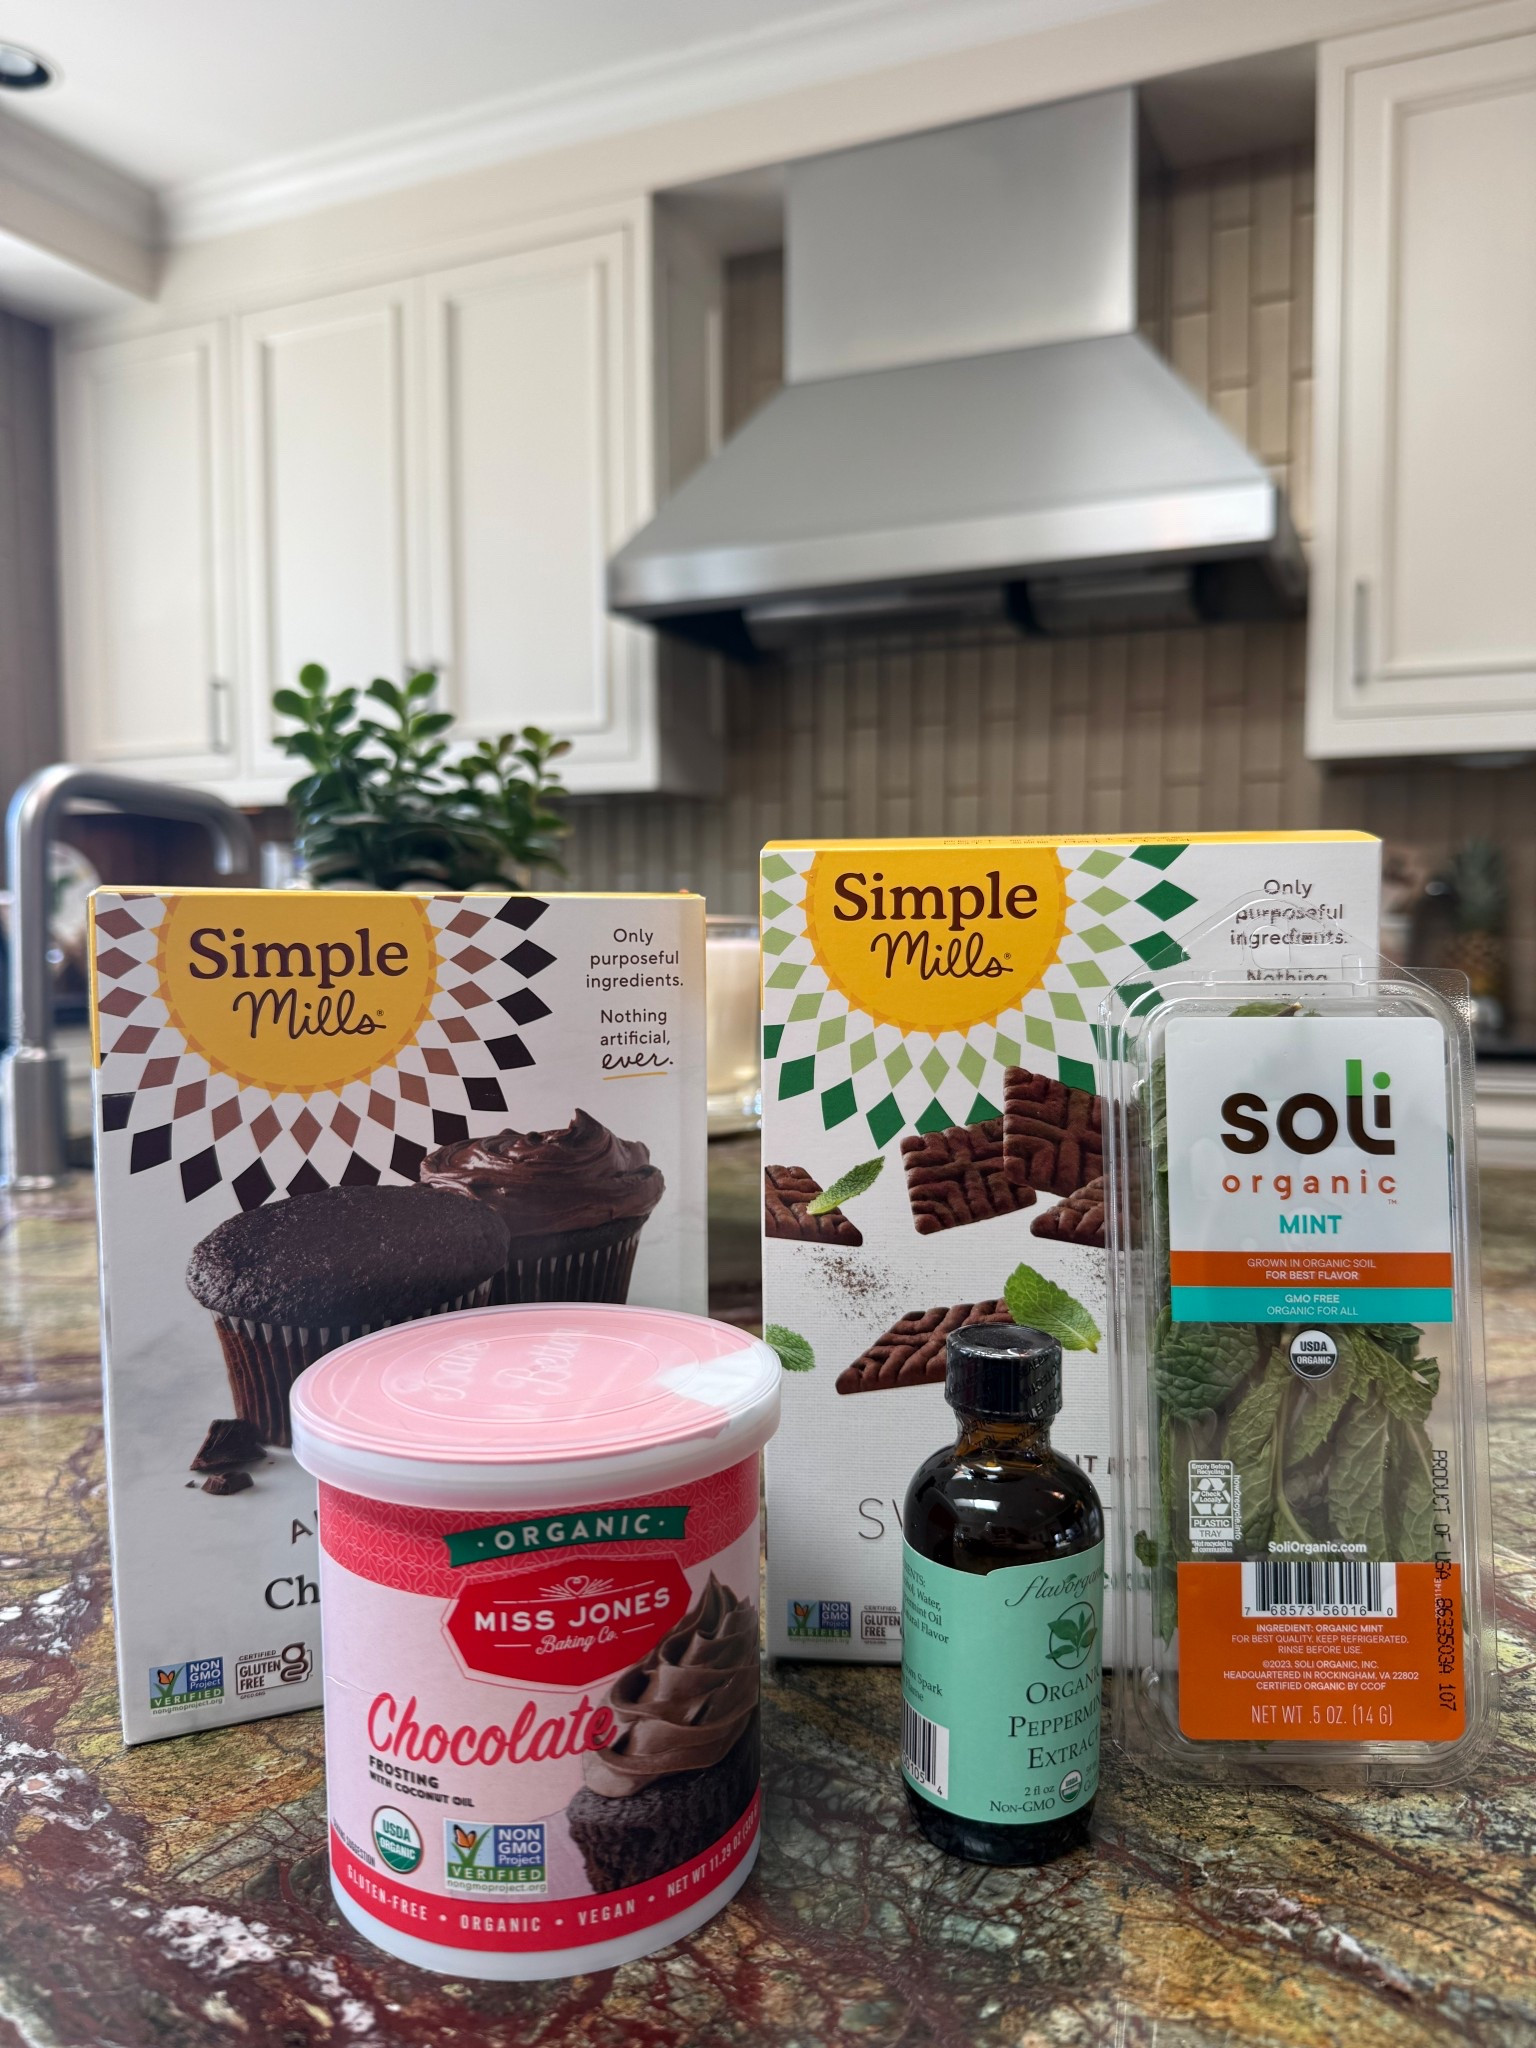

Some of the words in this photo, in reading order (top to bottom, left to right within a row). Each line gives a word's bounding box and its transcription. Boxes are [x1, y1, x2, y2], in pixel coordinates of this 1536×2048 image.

[1264, 879, 1313, 899] Only
[833, 870, 1038, 932] Simple
[1235, 904, 1344, 924] purposeful
[613, 928, 654, 946] Only
[189, 928, 409, 989] Simple
[590, 951, 679, 969] purposeful
[586, 973, 684, 991] ingredients.
[600, 1009, 667, 1025] Nothing
[600, 1030, 670, 1046] artificial,
[602, 1053, 674, 1070] ever.
[1220, 1059, 1396, 1155] soli
[1221, 1169, 1396, 1200] organic
[1279, 1214, 1342, 1234] MINT
[1247, 1258, 1287, 1268] GROWN
[1290, 1258, 1301, 1268] IN
[1302, 1258, 1350, 1268] ORGANIC
[1353, 1259, 1376, 1268] SOIL
[1265, 1270, 1287, 1280] FOR
[1289, 1270, 1315, 1280] BEST
[1317, 1271, 1359, 1280] FLAVOR
[1285, 1294, 1311, 1303] GMO
[1313, 1294, 1340, 1303] FREE
[1266, 1306, 1315, 1316] ORGANIC
[1317, 1306, 1338, 1316] FOR
[1340, 1306, 1359, 1316] ALL
[1300, 1341, 1328, 1352] USDA
[1296, 1355, 1332, 1365] ORGANIC
[1432, 1449, 1451, 1515] PRODUCT
[1193, 1519, 1230, 1527] PLASTIC
[494, 1514, 651, 1551] ORGANIC
[1200, 1529, 1222, 1537] TRAY
[1434, 1523, 1452, 1543] OF
[1268, 1541, 1367, 1554] SoliOrganic.com
[1435, 1551, 1452, 1580] USA
[822, 1602, 849, 1611] NON
[917, 1588, 941, 1611] Water,
[474, 1610, 555, 1632] MISS
[568, 1587, 670, 1628] JONES
[822, 1611, 849, 1620] GMO
[1244, 1607, 1250, 1616] 7
[1270, 1605, 1315, 1616] 68573
[1323, 1605, 1367, 1616] 56016
[1387, 1607, 1393, 1616] 0
[822, 1620, 849, 1628] Project
[864, 1614, 901, 1626] GLUTEN
[928, 1611, 942, 1626] Oil
[790, 1629, 849, 1637] VERIFIED
[864, 1626, 886, 1637] FREE
[921, 1621, 949, 1644] Flavor
[1256, 1624, 1314, 1632] INGREDIENT:
[1315, 1624, 1358, 1632] ORGANIC
[1360, 1624, 1383, 1633] MINT
[535, 1634, 595, 1655] Baking
[597, 1625, 618, 1644] Co.
[1231, 1634, 1250, 1643] FOR
[1251, 1634, 1273, 1643] BEST
[1316, 1635, 1339, 1643] KEEP
[1340, 1635, 1409, 1644] REFRIGERATED.
[238, 1649, 277, 1661] CERTIFIED
[1278, 1645, 1304, 1654] RINSE
[1306, 1645, 1341, 1654] BEFORE
[1343, 1645, 1363, 1654] USE.
[190, 1659, 220, 1673] NON
[239, 1660, 281, 1678] GLUTEN
[1294, 1660, 1314, 1668] SOLI
[1361, 1660, 1379, 1669] INC.
[190, 1669, 221, 1682] GMO
[240, 1675, 265, 1691] FREE
[1223, 1671, 1301, 1679] HEADQUARTERED
[1303, 1671, 1312, 1679] IN
[1379, 1671, 1391, 1680] VA
[1392, 1671, 1419, 1680] 22802
[190, 1679, 221, 1690] Project
[918, 1673, 943, 1697] Spark
[1256, 1681, 1302, 1690] CERTIFIED
[1303, 1681, 1345, 1690] ORGANIC
[1347, 1682, 1358, 1690] BY
[1360, 1682, 1386, 1691] CCOF
[154, 1688, 222, 1707] VERIFIED
[1439, 1683, 1457, 1712] 107
[152, 1698, 223, 1715] nongmoproject.org
[1251, 1704, 1277, 1724] NET
[1282, 1704, 1303, 1724] WT
[1309, 1705, 1320, 1724] .5
[1326, 1705, 1347, 1724] OZ.
[1352, 1703, 1374, 1726] (14
[1379, 1703, 1393, 1726] G)
[368, 1692, 618, 1766] Chocolate
[369, 1754, 439, 1789] FROSTING
[369, 1769, 393, 1788] WITH
[395, 1782, 450, 1804] COCONUT
[452, 1796, 475, 1807] OIL
[937, 1786, 943, 1796] 4
[1024, 1786, 1031, 1796] 2
[1033, 1785, 1041, 1796] fl
[1043, 1785, 1055, 1794] oz
[382, 1819, 412, 1843] USDA
[499, 1828, 540, 1841] NON
[379, 1837, 416, 1860] ORGANIC
[499, 1841, 541, 1854] GMO
[499, 1854, 541, 1867] Project
[347, 1864, 428, 1921] GLUTEN-FREE
[460, 1914, 541, 1932] ORGANIC
[578, 1899, 635, 1926] VEGAN
[667, 1874, 689, 1898] NET
[691, 1865, 707, 1885] WT
[709, 1844, 732, 1872] 11.29
[733, 1830, 742, 1850] OZ
[451, 1867, 542, 1880] VERIFIED
[447, 1879, 547, 1893] nongmoproject.org
